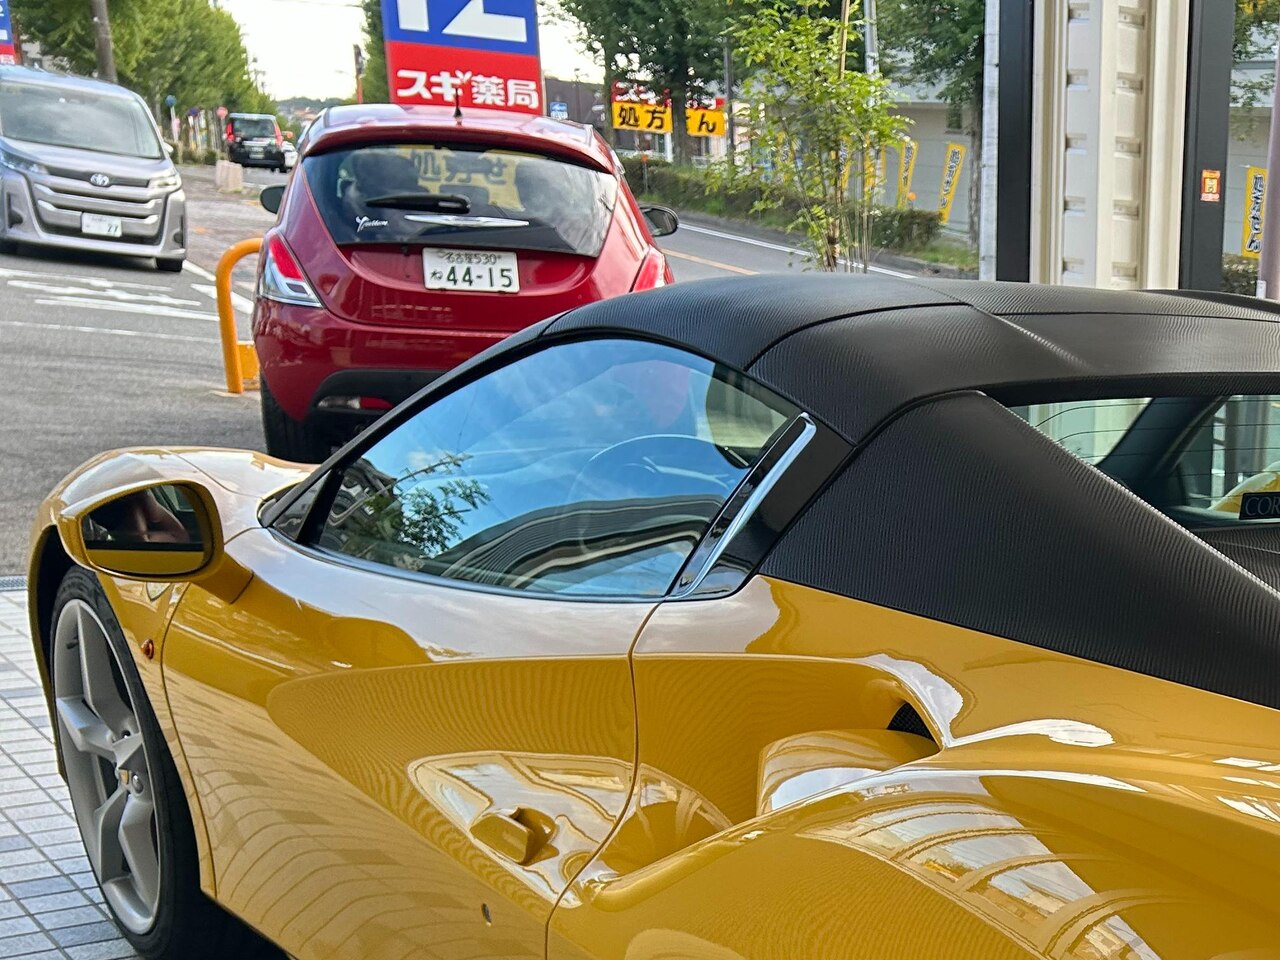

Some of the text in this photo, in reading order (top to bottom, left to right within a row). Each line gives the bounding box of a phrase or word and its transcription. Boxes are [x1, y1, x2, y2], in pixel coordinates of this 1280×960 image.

[396, 68, 540, 110] スギ薬局
[618, 106, 717, 134] 処方ん
[446, 265, 513, 288] 44-15
